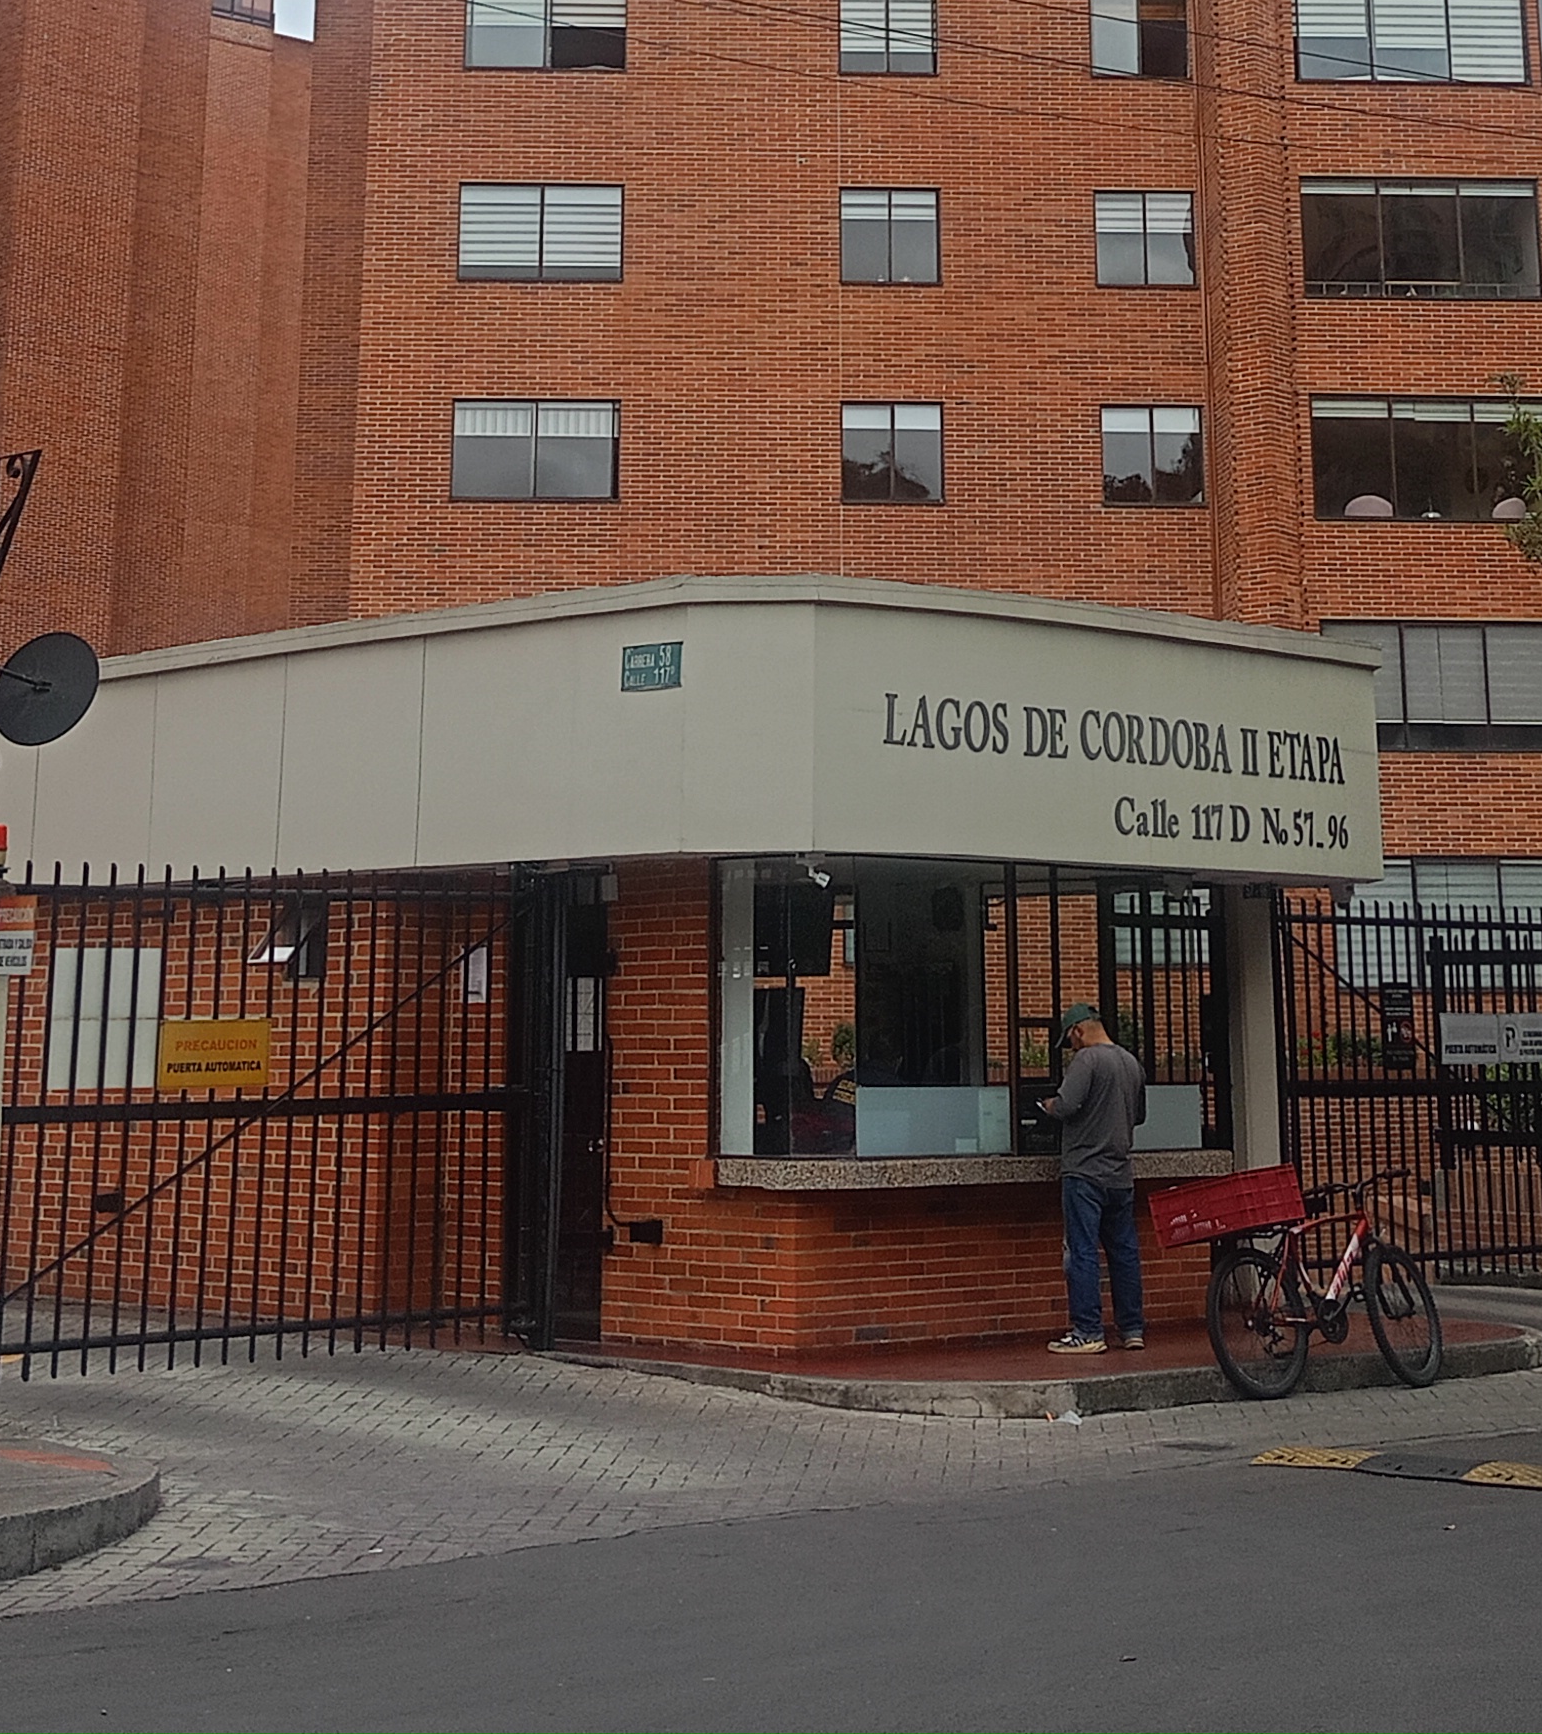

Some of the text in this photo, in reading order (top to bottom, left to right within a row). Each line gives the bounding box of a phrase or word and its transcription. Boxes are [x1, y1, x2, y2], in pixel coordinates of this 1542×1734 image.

[659, 645, 671, 666] 58
[882, 692, 1346, 785] LAGOS DE CORDOBA II ETAPA
[1114, 795, 1181, 839] Calle
[1191, 803, 1224, 841] 117
[1229, 804, 1251, 843] D
[175, 1039, 258, 1051] PRECAUCION
[166, 1060, 262, 1074] PUERTA AUTOMATICA
